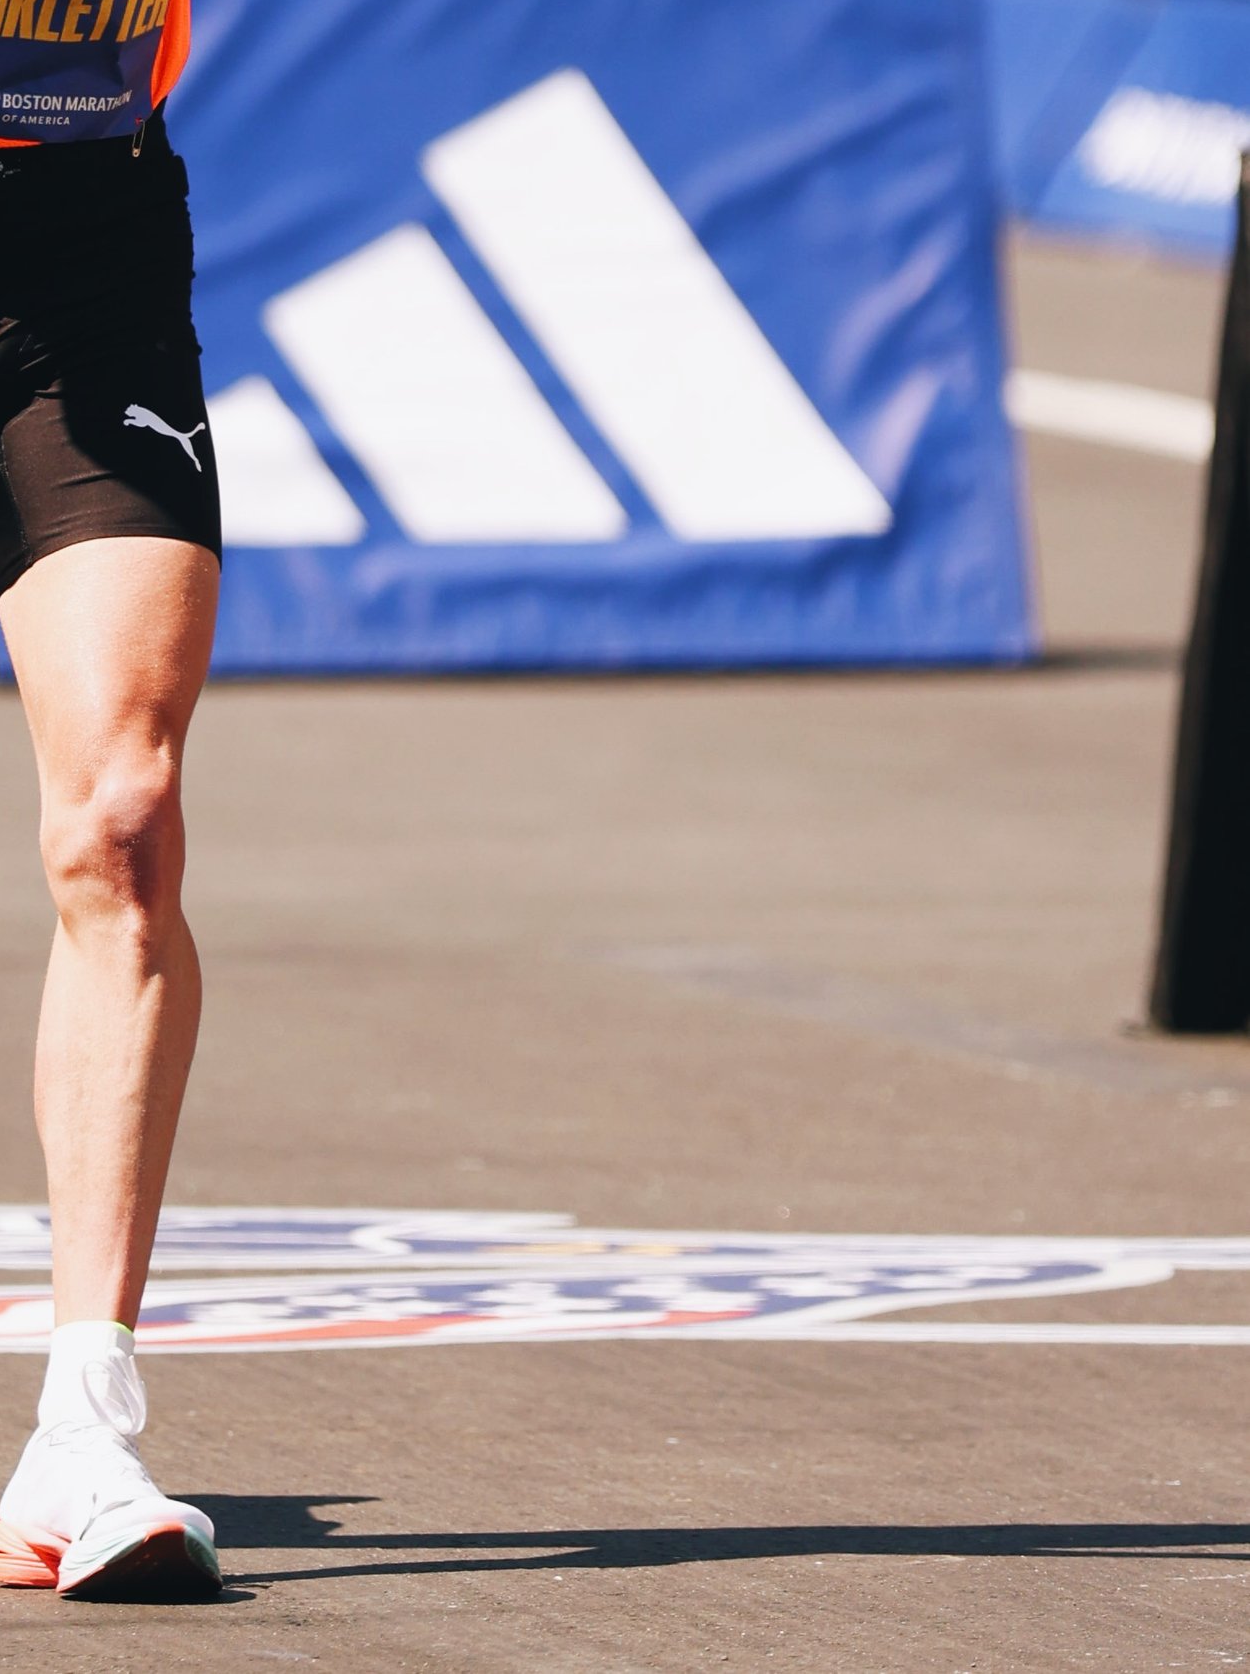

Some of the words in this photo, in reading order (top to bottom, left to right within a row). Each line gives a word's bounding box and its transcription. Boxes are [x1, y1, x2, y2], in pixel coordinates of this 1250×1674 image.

[2, 93, 62, 110] BOSTON
[65, 89, 132, 112] MARATHON
[2, 114, 17, 123] OF
[19, 115, 71, 125] AMERICA
